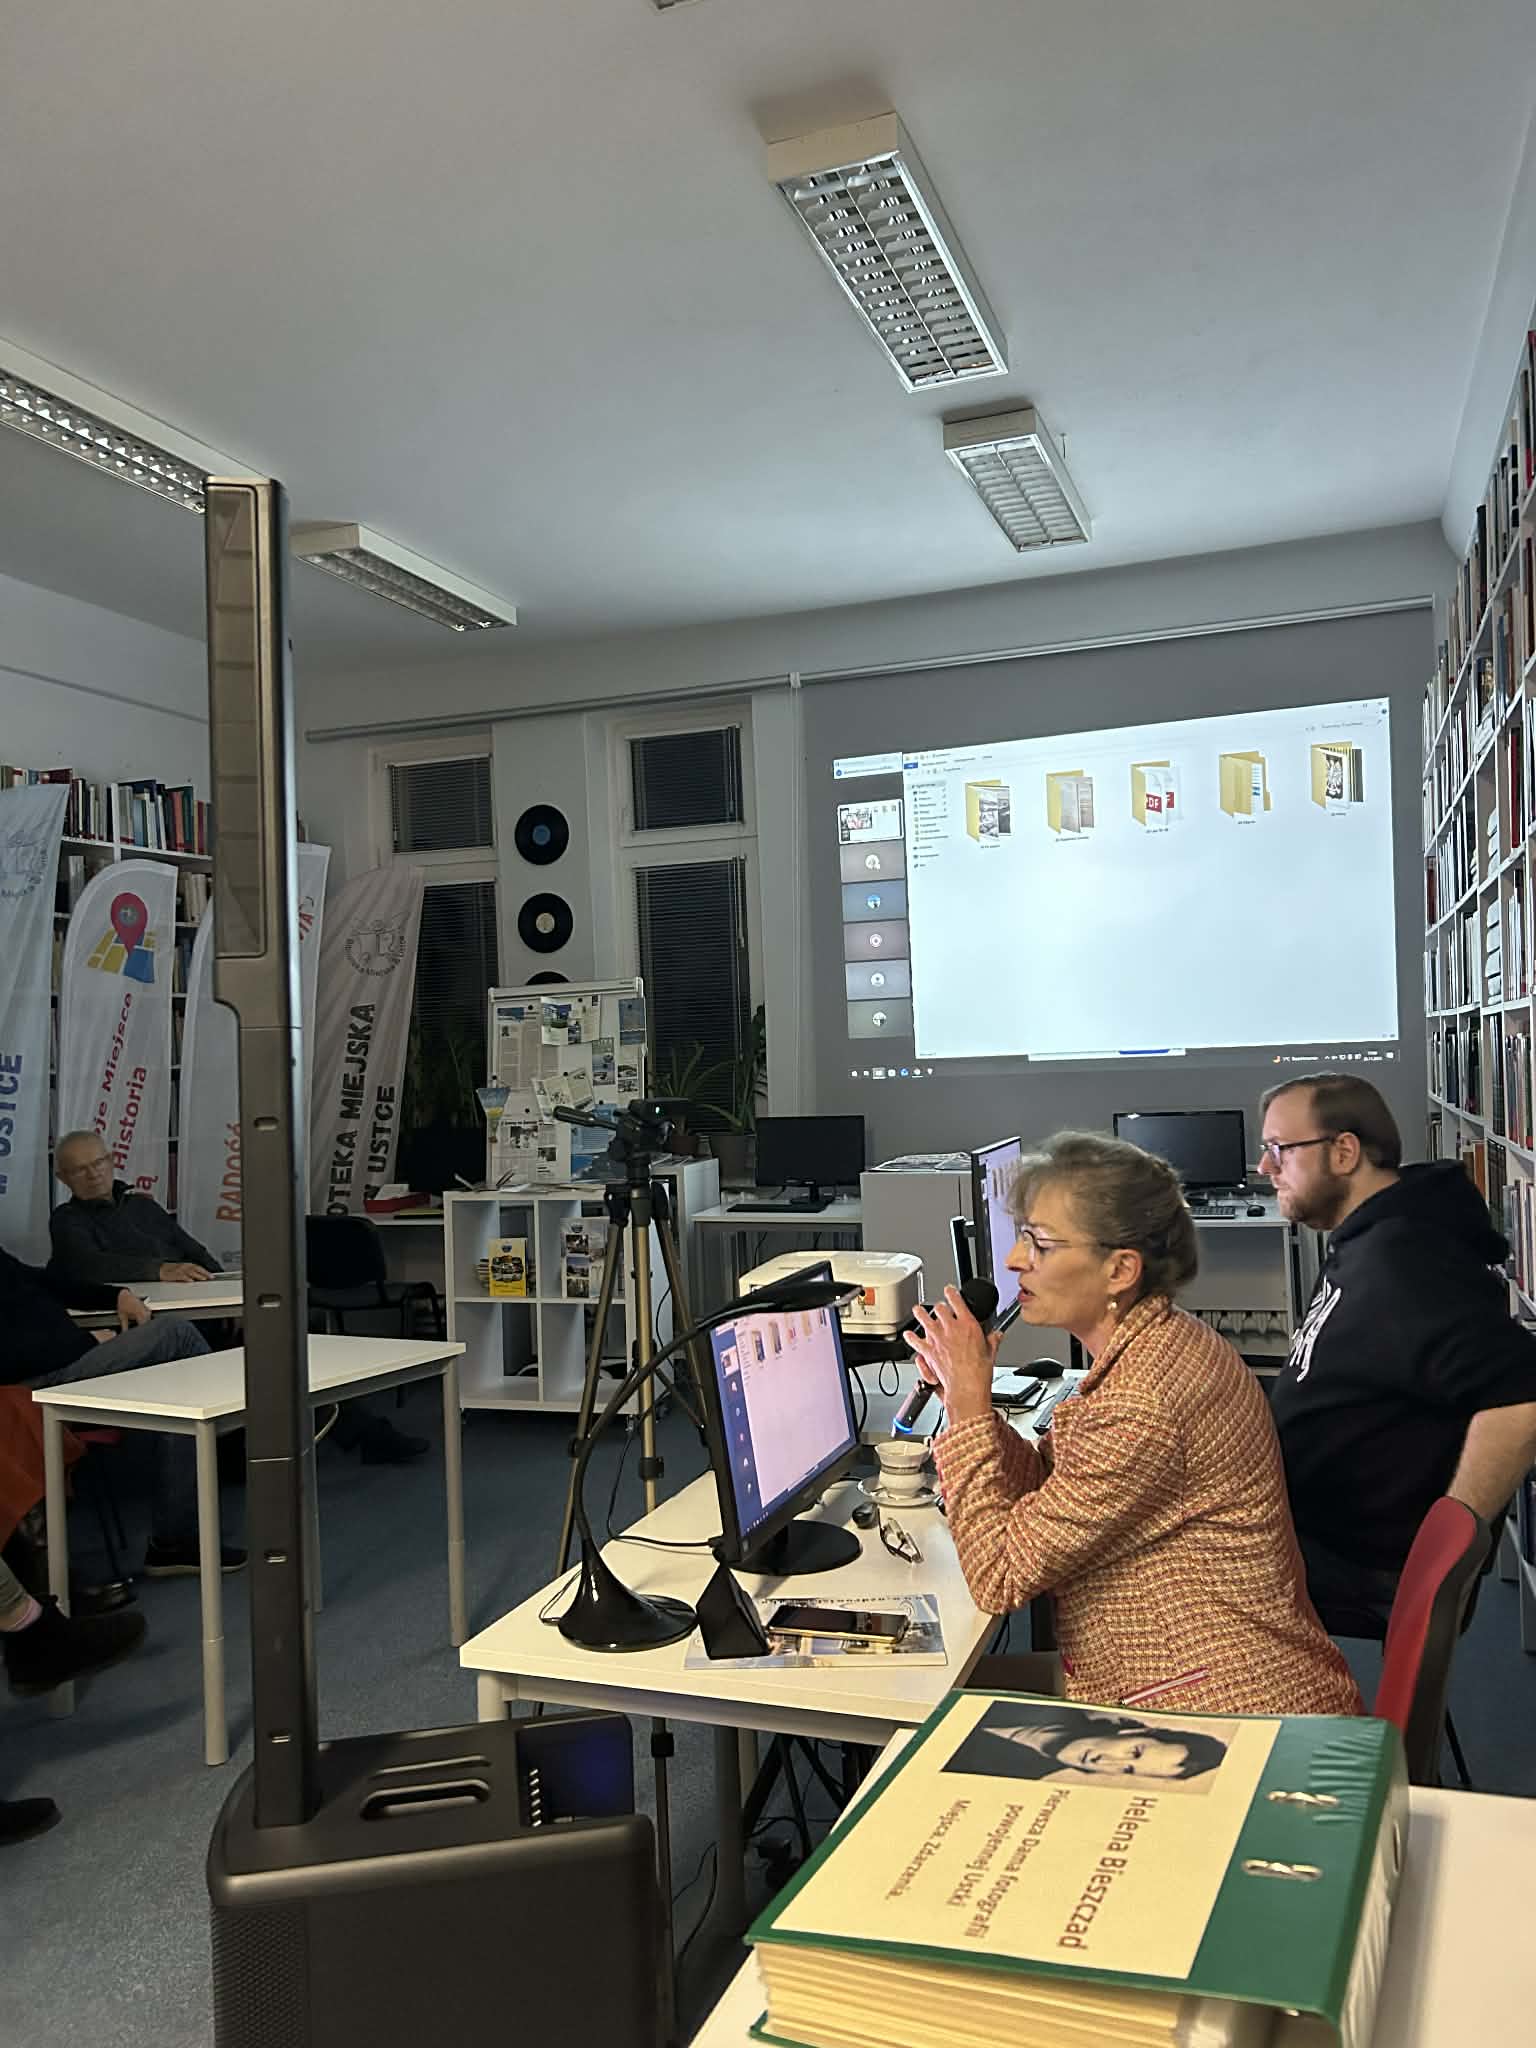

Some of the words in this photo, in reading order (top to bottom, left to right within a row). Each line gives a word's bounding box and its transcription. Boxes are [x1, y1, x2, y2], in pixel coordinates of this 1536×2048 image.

[101, 992, 133, 1093] Miejsce
[339, 1003, 376, 1120] MIEJSKA
[112, 1067, 147, 1170] Historia
[367, 1085, 395, 1173] USTCE
[327, 1129, 358, 1216] OTEKA
[965, 1803, 1025, 1872] powojennej
[1027, 1788, 1071, 1836] Pierwsza
[1106, 1796, 1159, 1852] Helena
[946, 1872, 985, 1908] Ustki
[1003, 1838, 1041, 1872] Dama
[963, 1874, 1019, 1938] fotografii
[1057, 1857, 1128, 1950] Bieszczad
